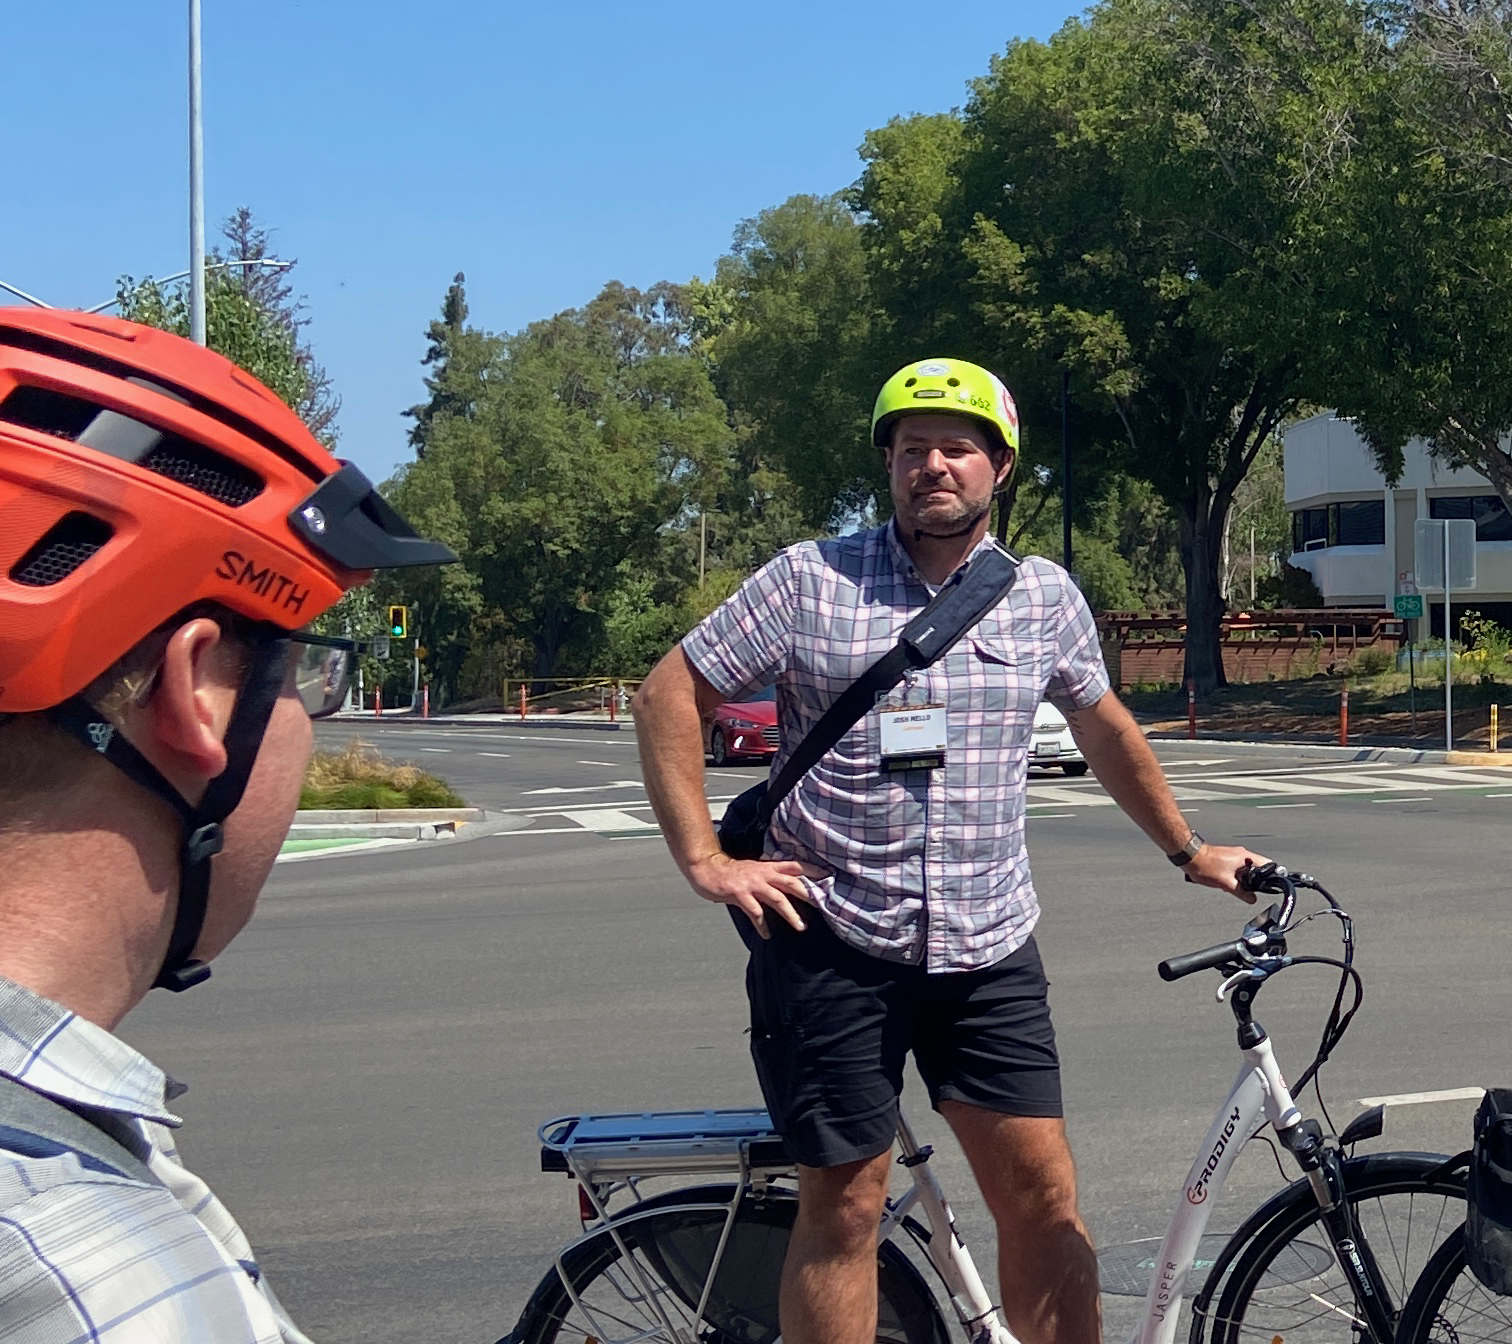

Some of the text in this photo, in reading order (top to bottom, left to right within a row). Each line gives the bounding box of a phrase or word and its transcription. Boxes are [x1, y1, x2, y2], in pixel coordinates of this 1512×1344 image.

[215, 551, 310, 614] SMITH
[1192, 1106, 1241, 1198] PRODIGY
[1152, 1261, 1178, 1323] JASPER
